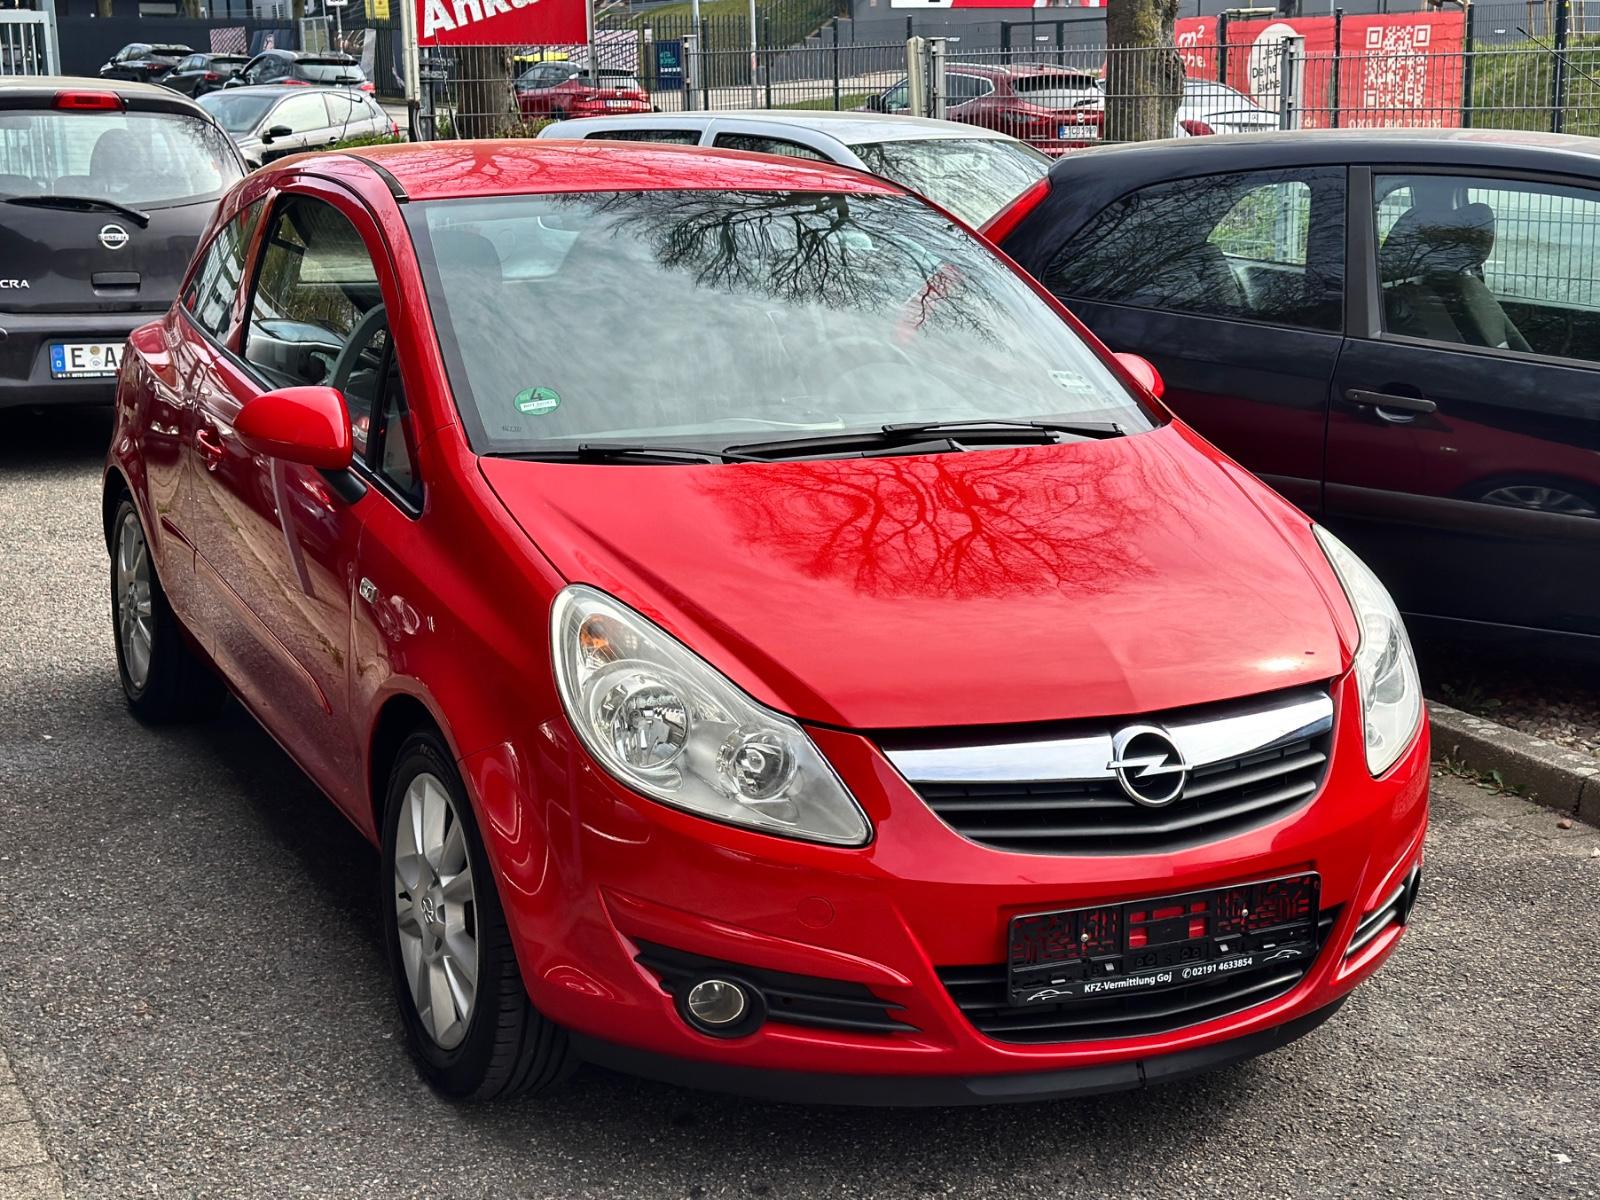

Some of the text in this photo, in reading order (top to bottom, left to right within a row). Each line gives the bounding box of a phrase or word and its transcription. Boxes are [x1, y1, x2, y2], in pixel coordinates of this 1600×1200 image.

[1252, 63, 1278, 79] Deine
[0, 279, 30, 289] CRA
[71, 347, 86, 368] E
[1084, 957, 1253, 993] KFZ-Vermittlung Goj 02191 4633854
